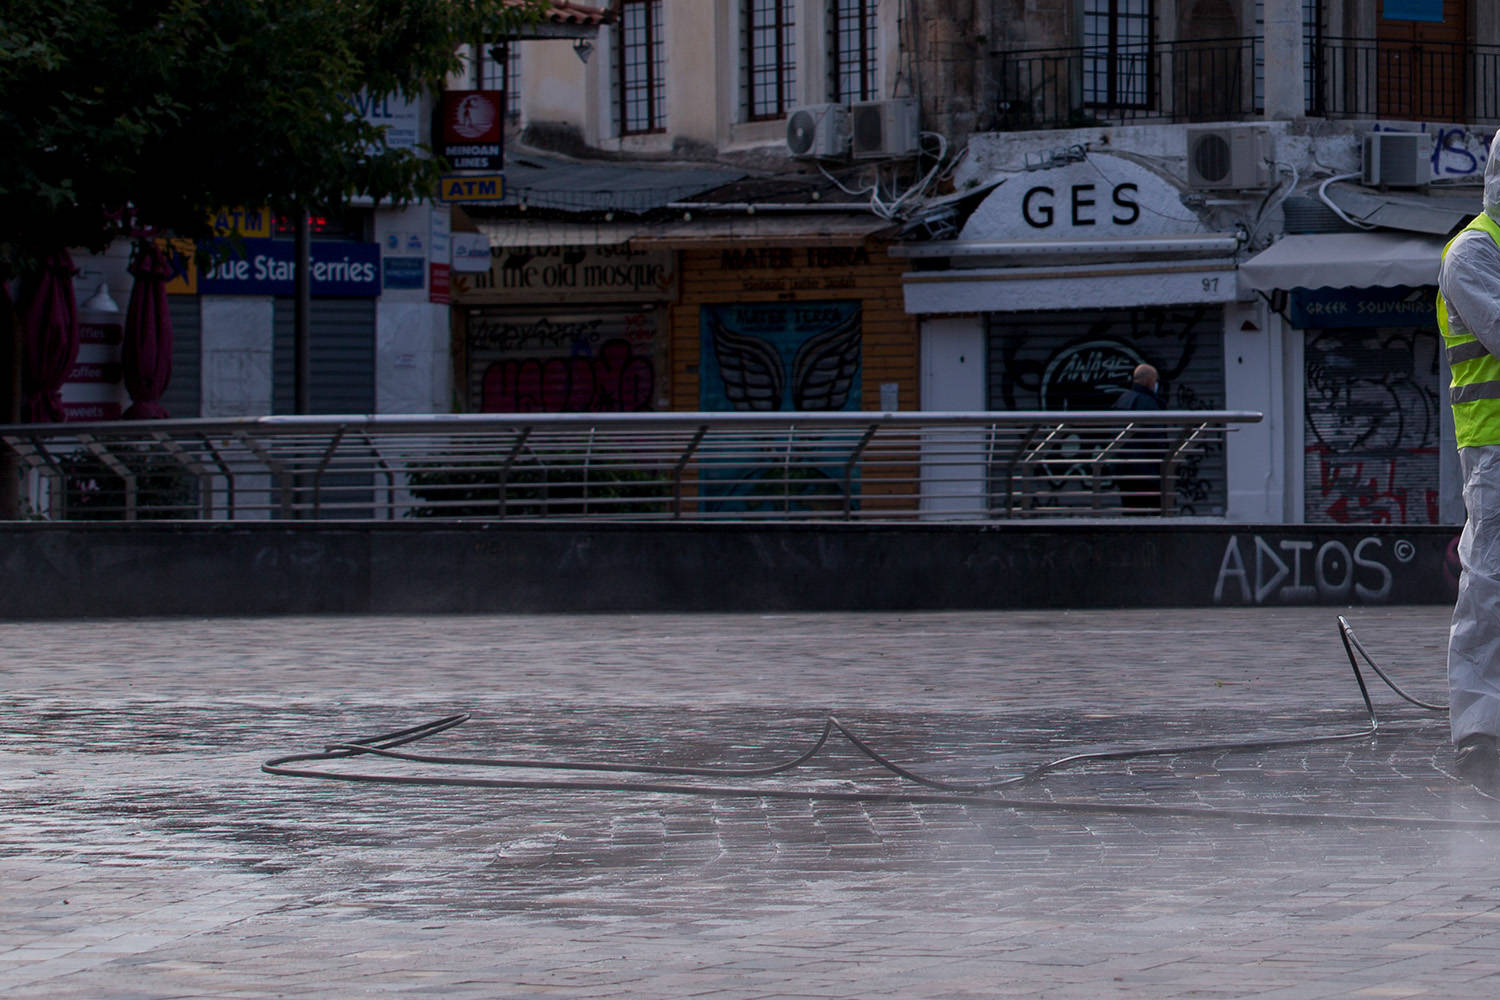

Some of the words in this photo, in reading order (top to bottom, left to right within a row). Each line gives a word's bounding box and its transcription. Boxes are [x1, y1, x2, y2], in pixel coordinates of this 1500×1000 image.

[446, 145, 500, 157] MINOAN
[454, 157, 490, 168] LINES
[449, 179, 498, 198] ATM
[1022, 183, 1140, 228] GES
[215, 208, 263, 231] ATM
[254, 254, 296, 281] Star
[309, 256, 376, 283] erries
[543, 262, 577, 288] old
[584, 263, 666, 291] mosque
[1202, 278, 1219, 293] 97
[1306, 301, 1348, 315] GREEK
[1357, 300, 1433, 314] SOUVENIRS
